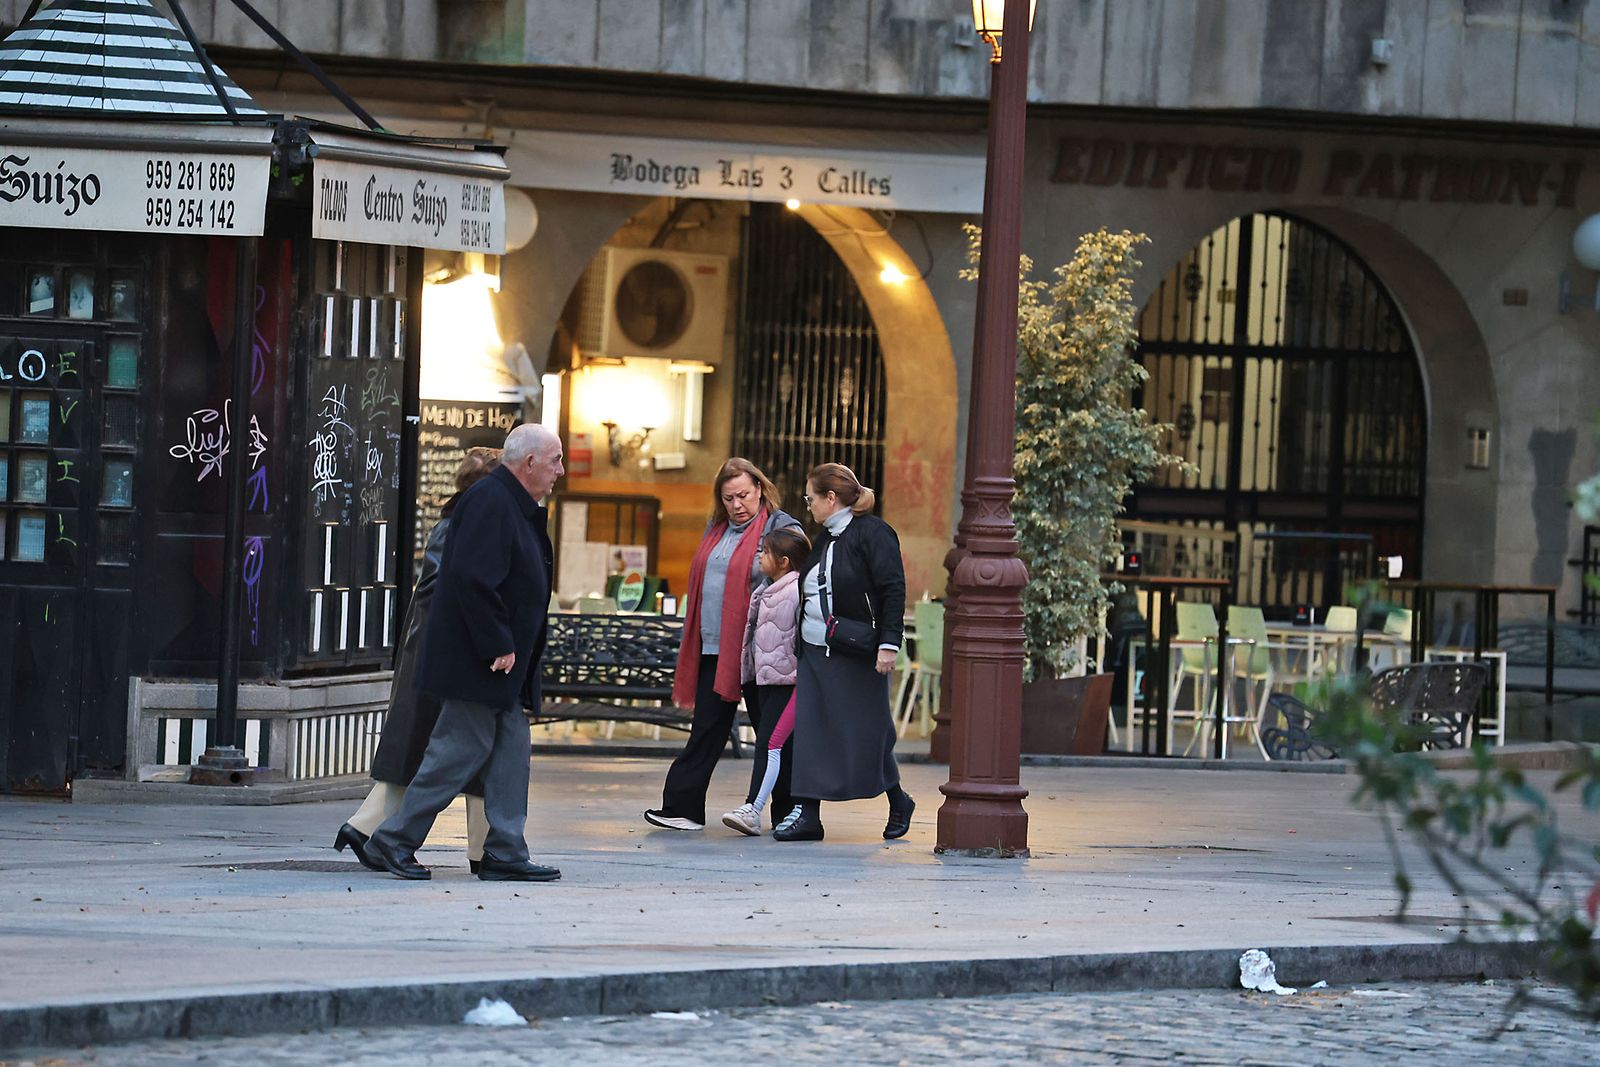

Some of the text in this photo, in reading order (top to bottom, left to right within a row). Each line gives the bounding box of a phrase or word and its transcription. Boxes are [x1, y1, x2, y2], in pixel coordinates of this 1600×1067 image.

[146, 160, 235, 191] 959 281 869
[610, 153, 892, 197] Bodega Las 3 Calles
[1049, 134, 1302, 193] EDIFICIO
[146, 198, 235, 229] 959 254 142
[320, 178, 348, 222] TOLDOS
[363, 174, 404, 223] Centro
[465, 408, 485, 429] DE
